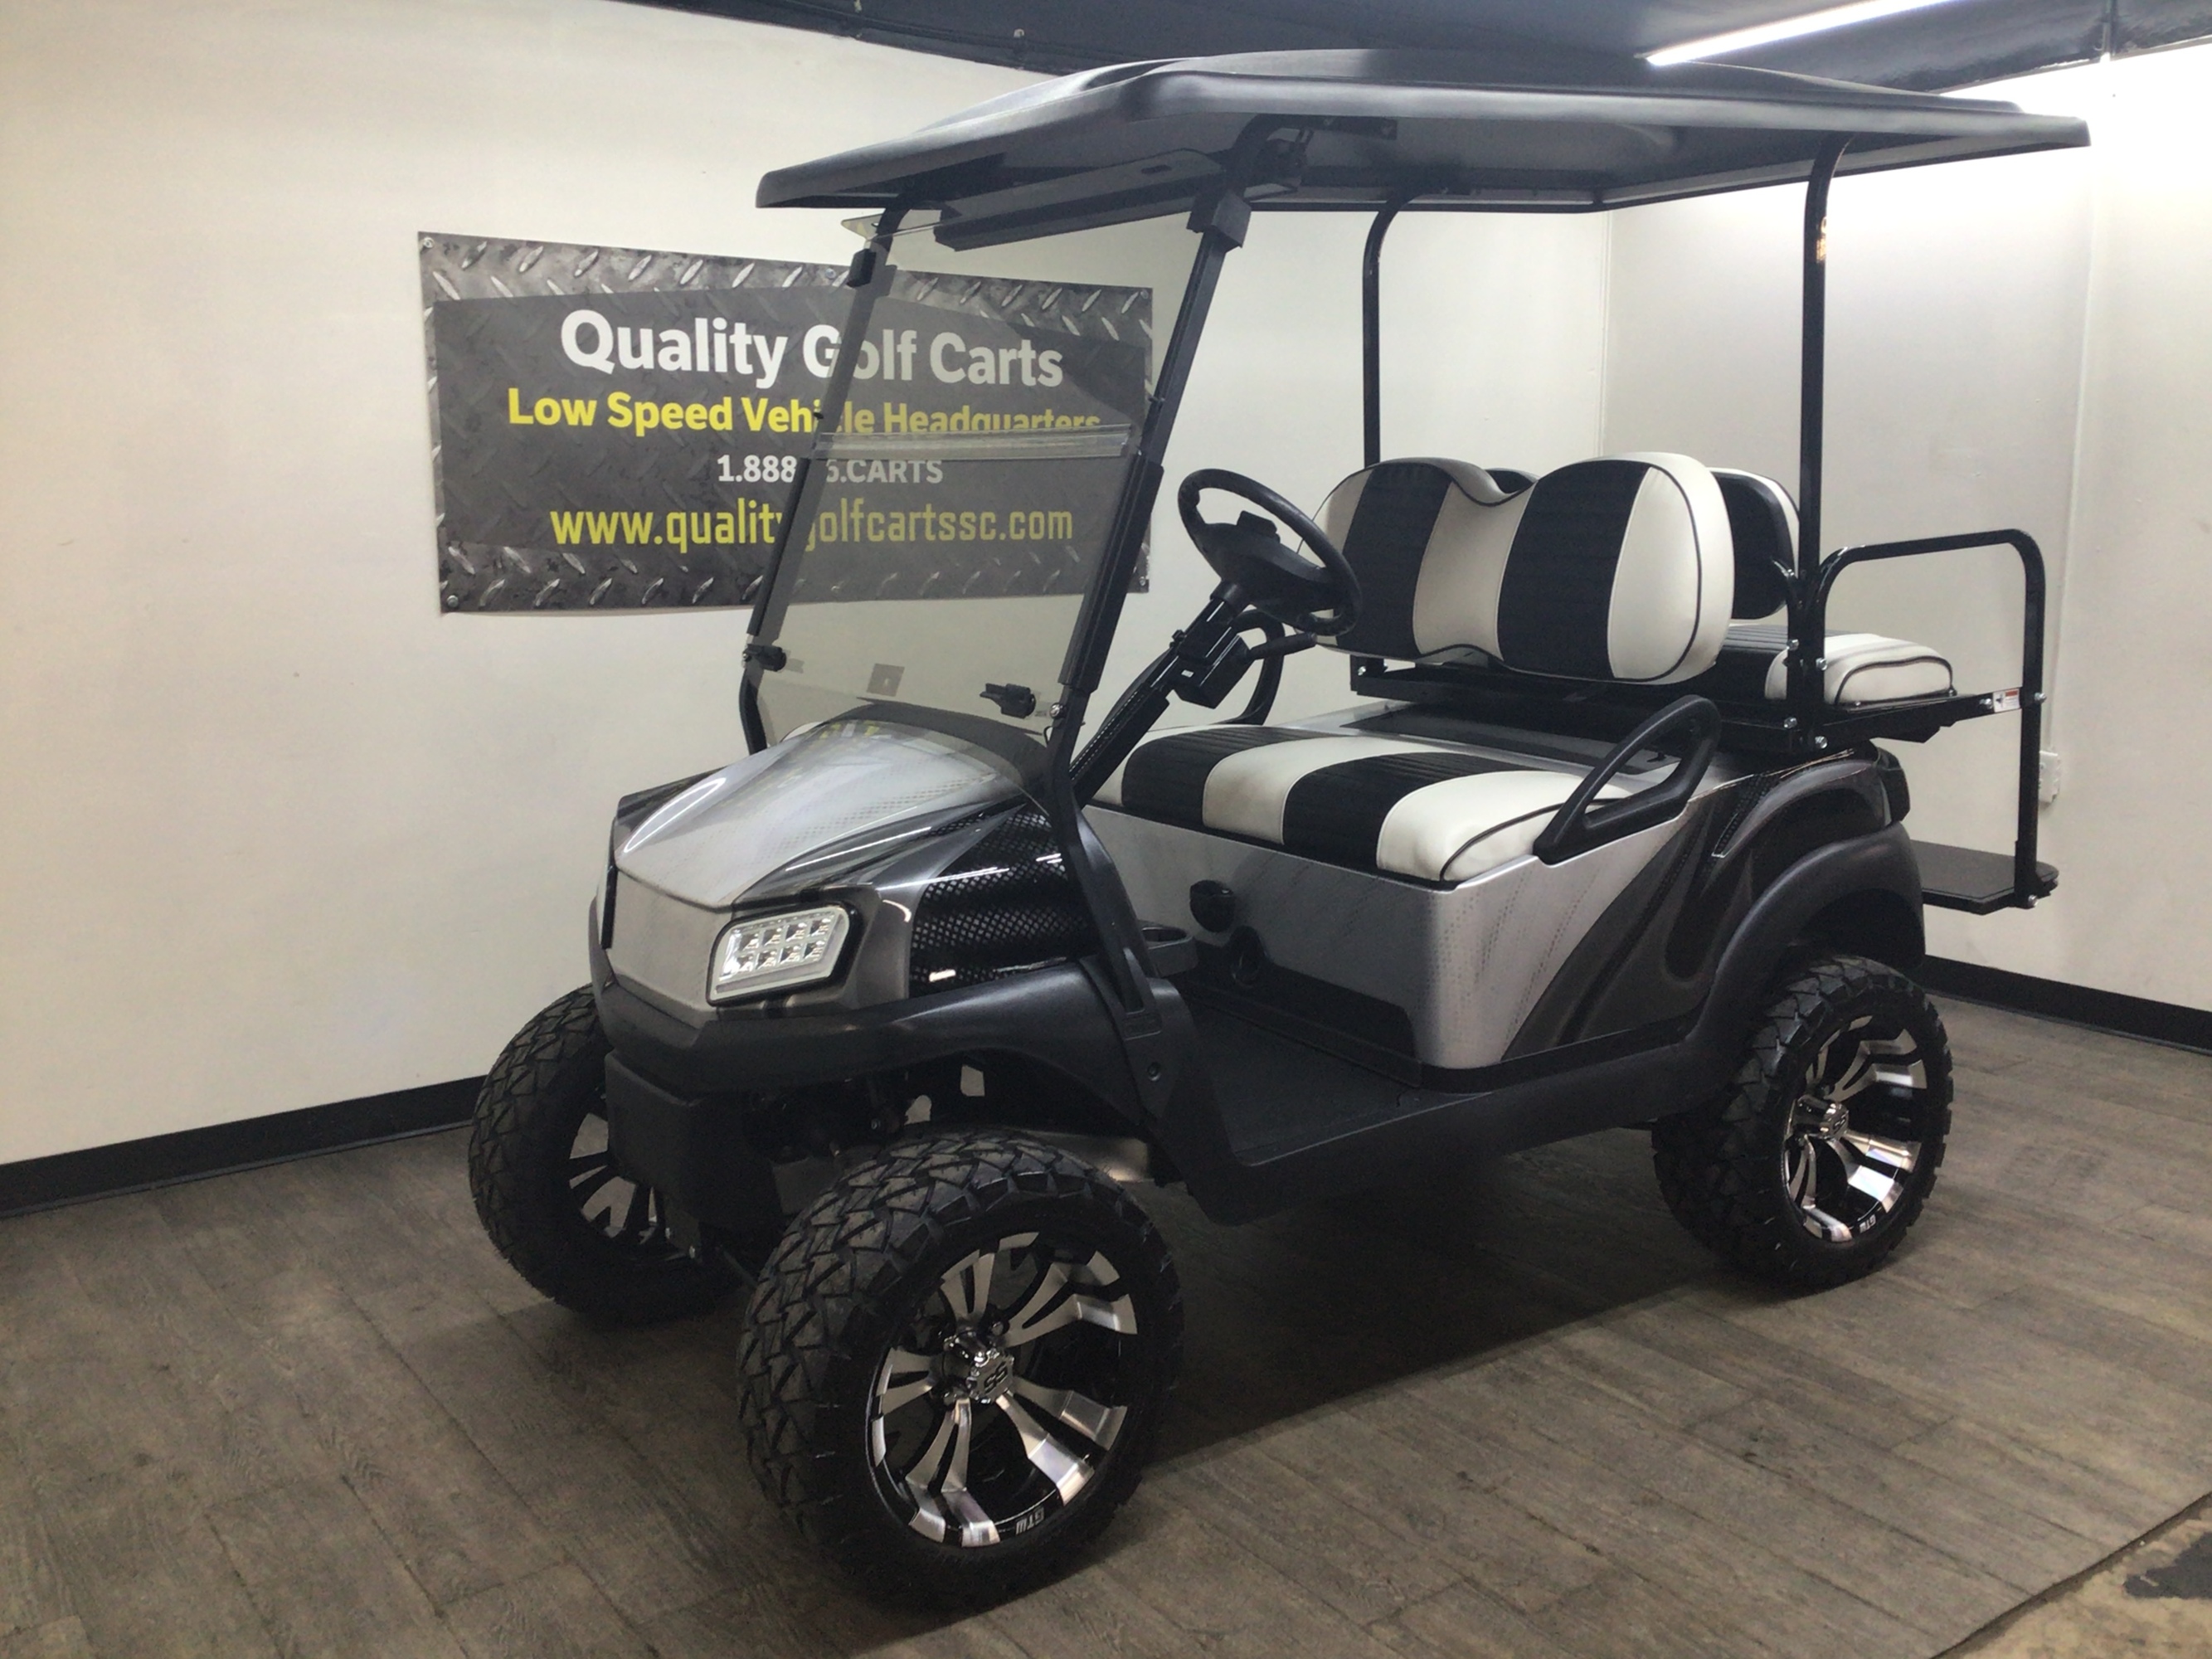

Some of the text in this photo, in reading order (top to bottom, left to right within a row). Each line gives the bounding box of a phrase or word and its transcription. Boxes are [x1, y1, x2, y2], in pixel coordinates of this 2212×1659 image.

[561, 309, 1063, 390] Quality Golf Carts
[508, 387, 598, 426] Low
[607, 391, 733, 437] Speed
[1016, 1506, 1045, 1535] GTW
